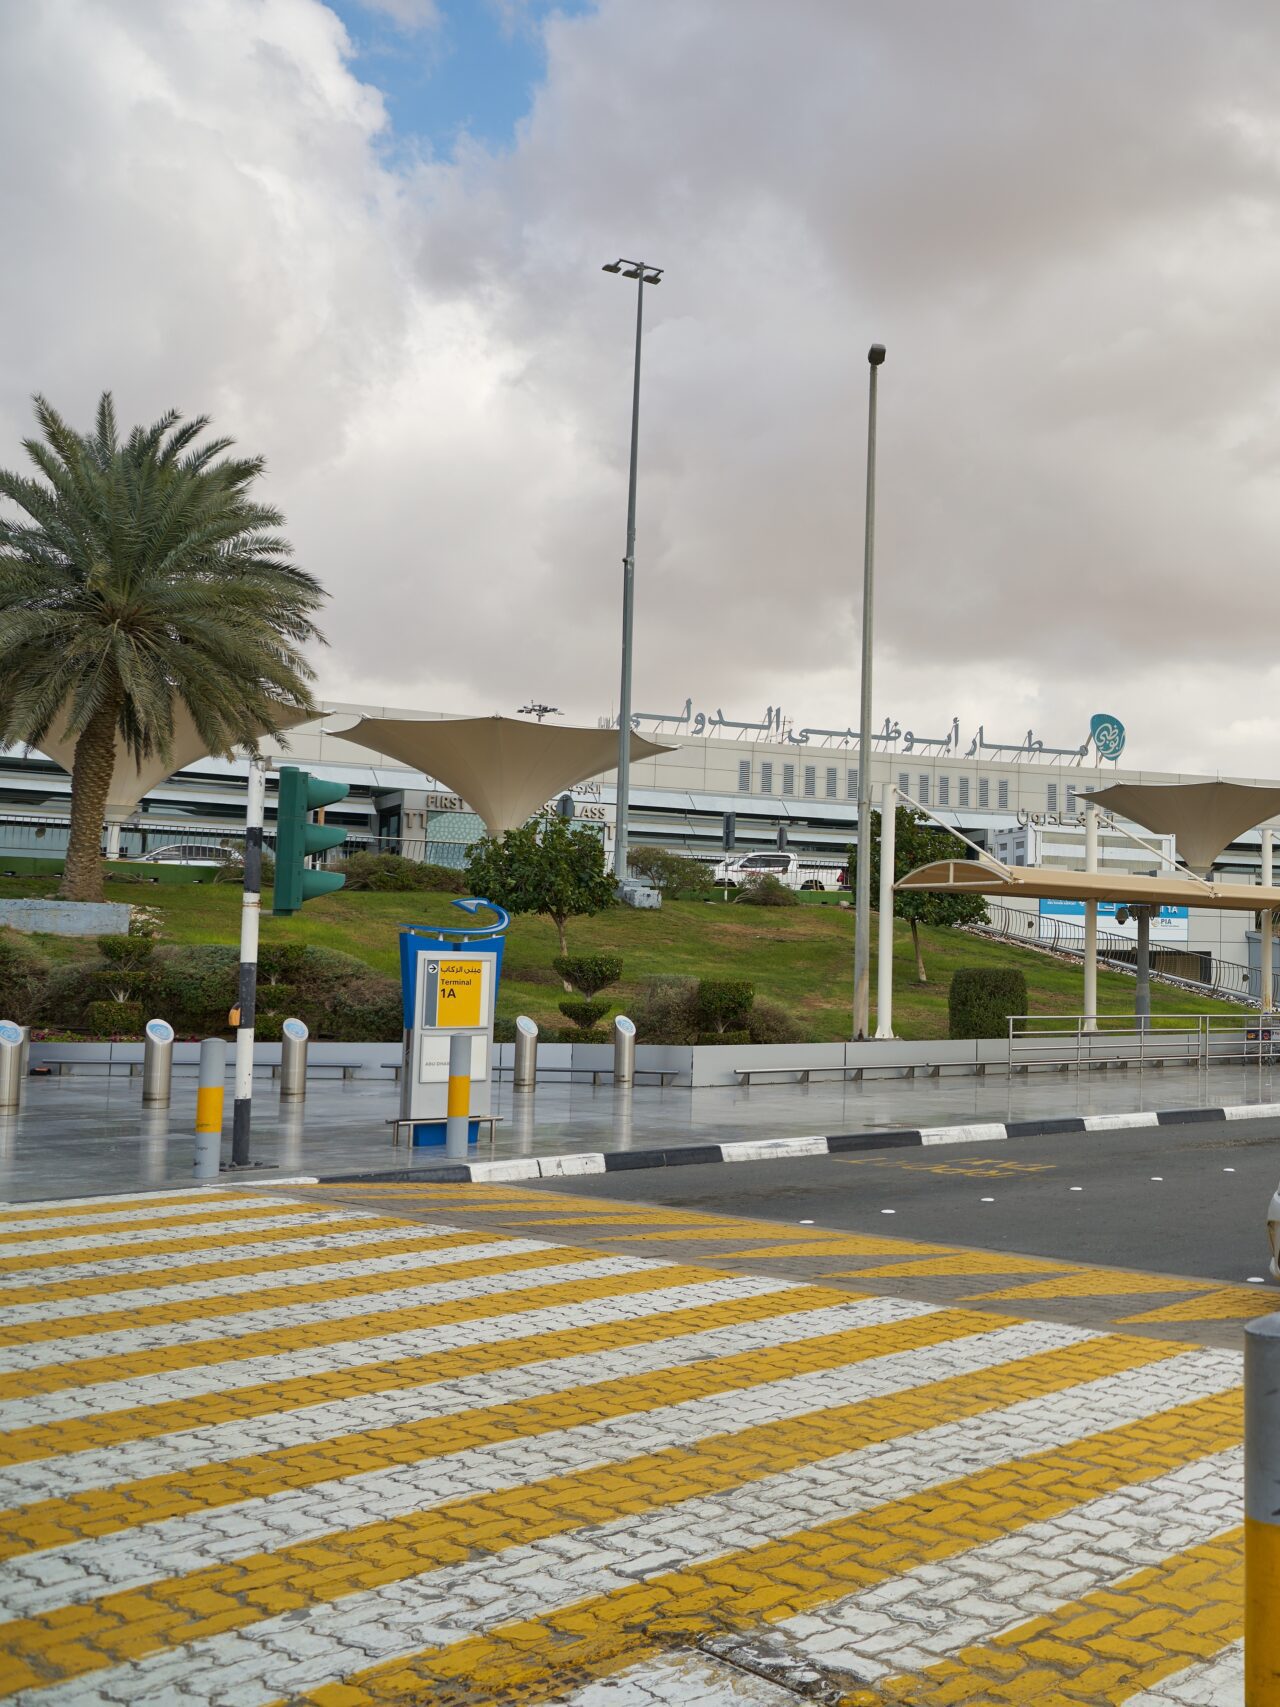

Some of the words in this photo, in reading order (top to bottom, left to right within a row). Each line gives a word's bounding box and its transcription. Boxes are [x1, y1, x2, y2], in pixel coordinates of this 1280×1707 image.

[965, 725, 1089, 756] مطار
[426, 794, 465, 810] FIRST
[573, 804, 606, 819] LASS
[441, 988, 456, 998] 1A
